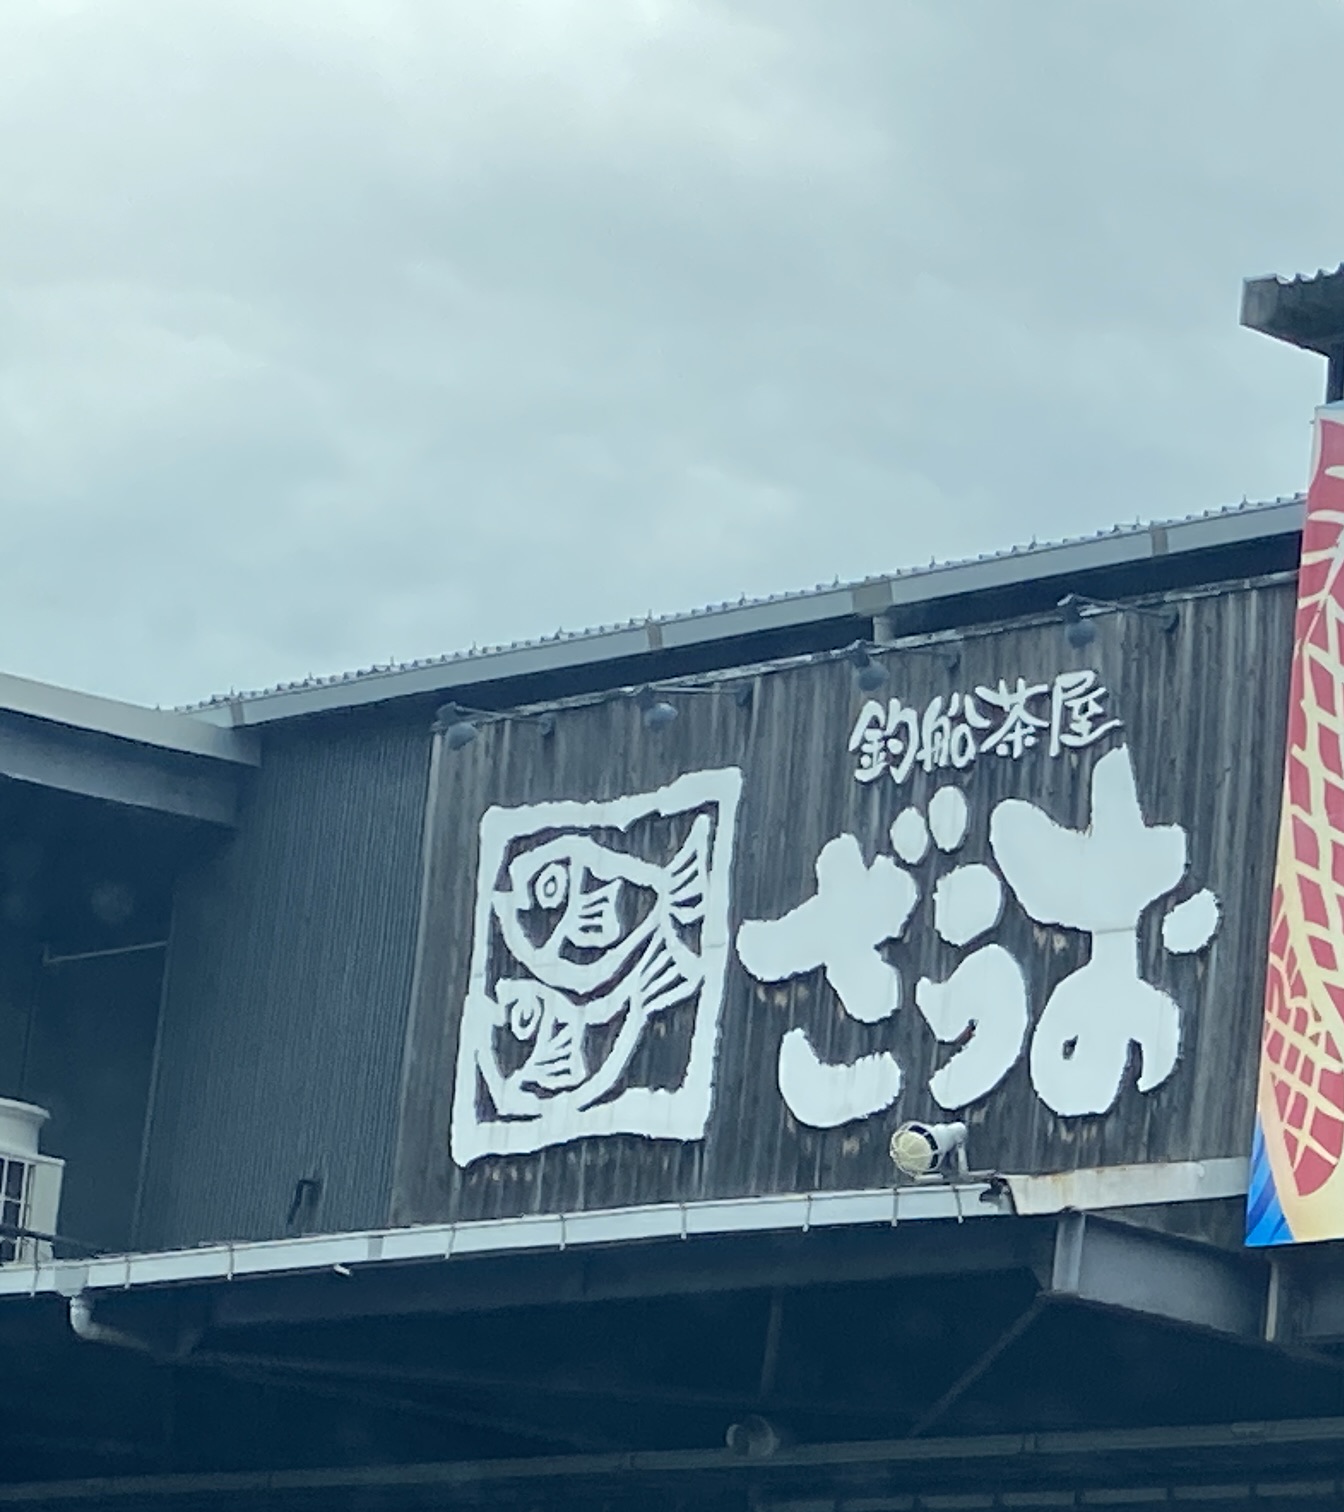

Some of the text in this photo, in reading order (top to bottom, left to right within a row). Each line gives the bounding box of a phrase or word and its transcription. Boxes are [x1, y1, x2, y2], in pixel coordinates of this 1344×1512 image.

[848, 669, 1125, 785] 釣船茶屋
[736, 743, 1221, 1129] ざうお
